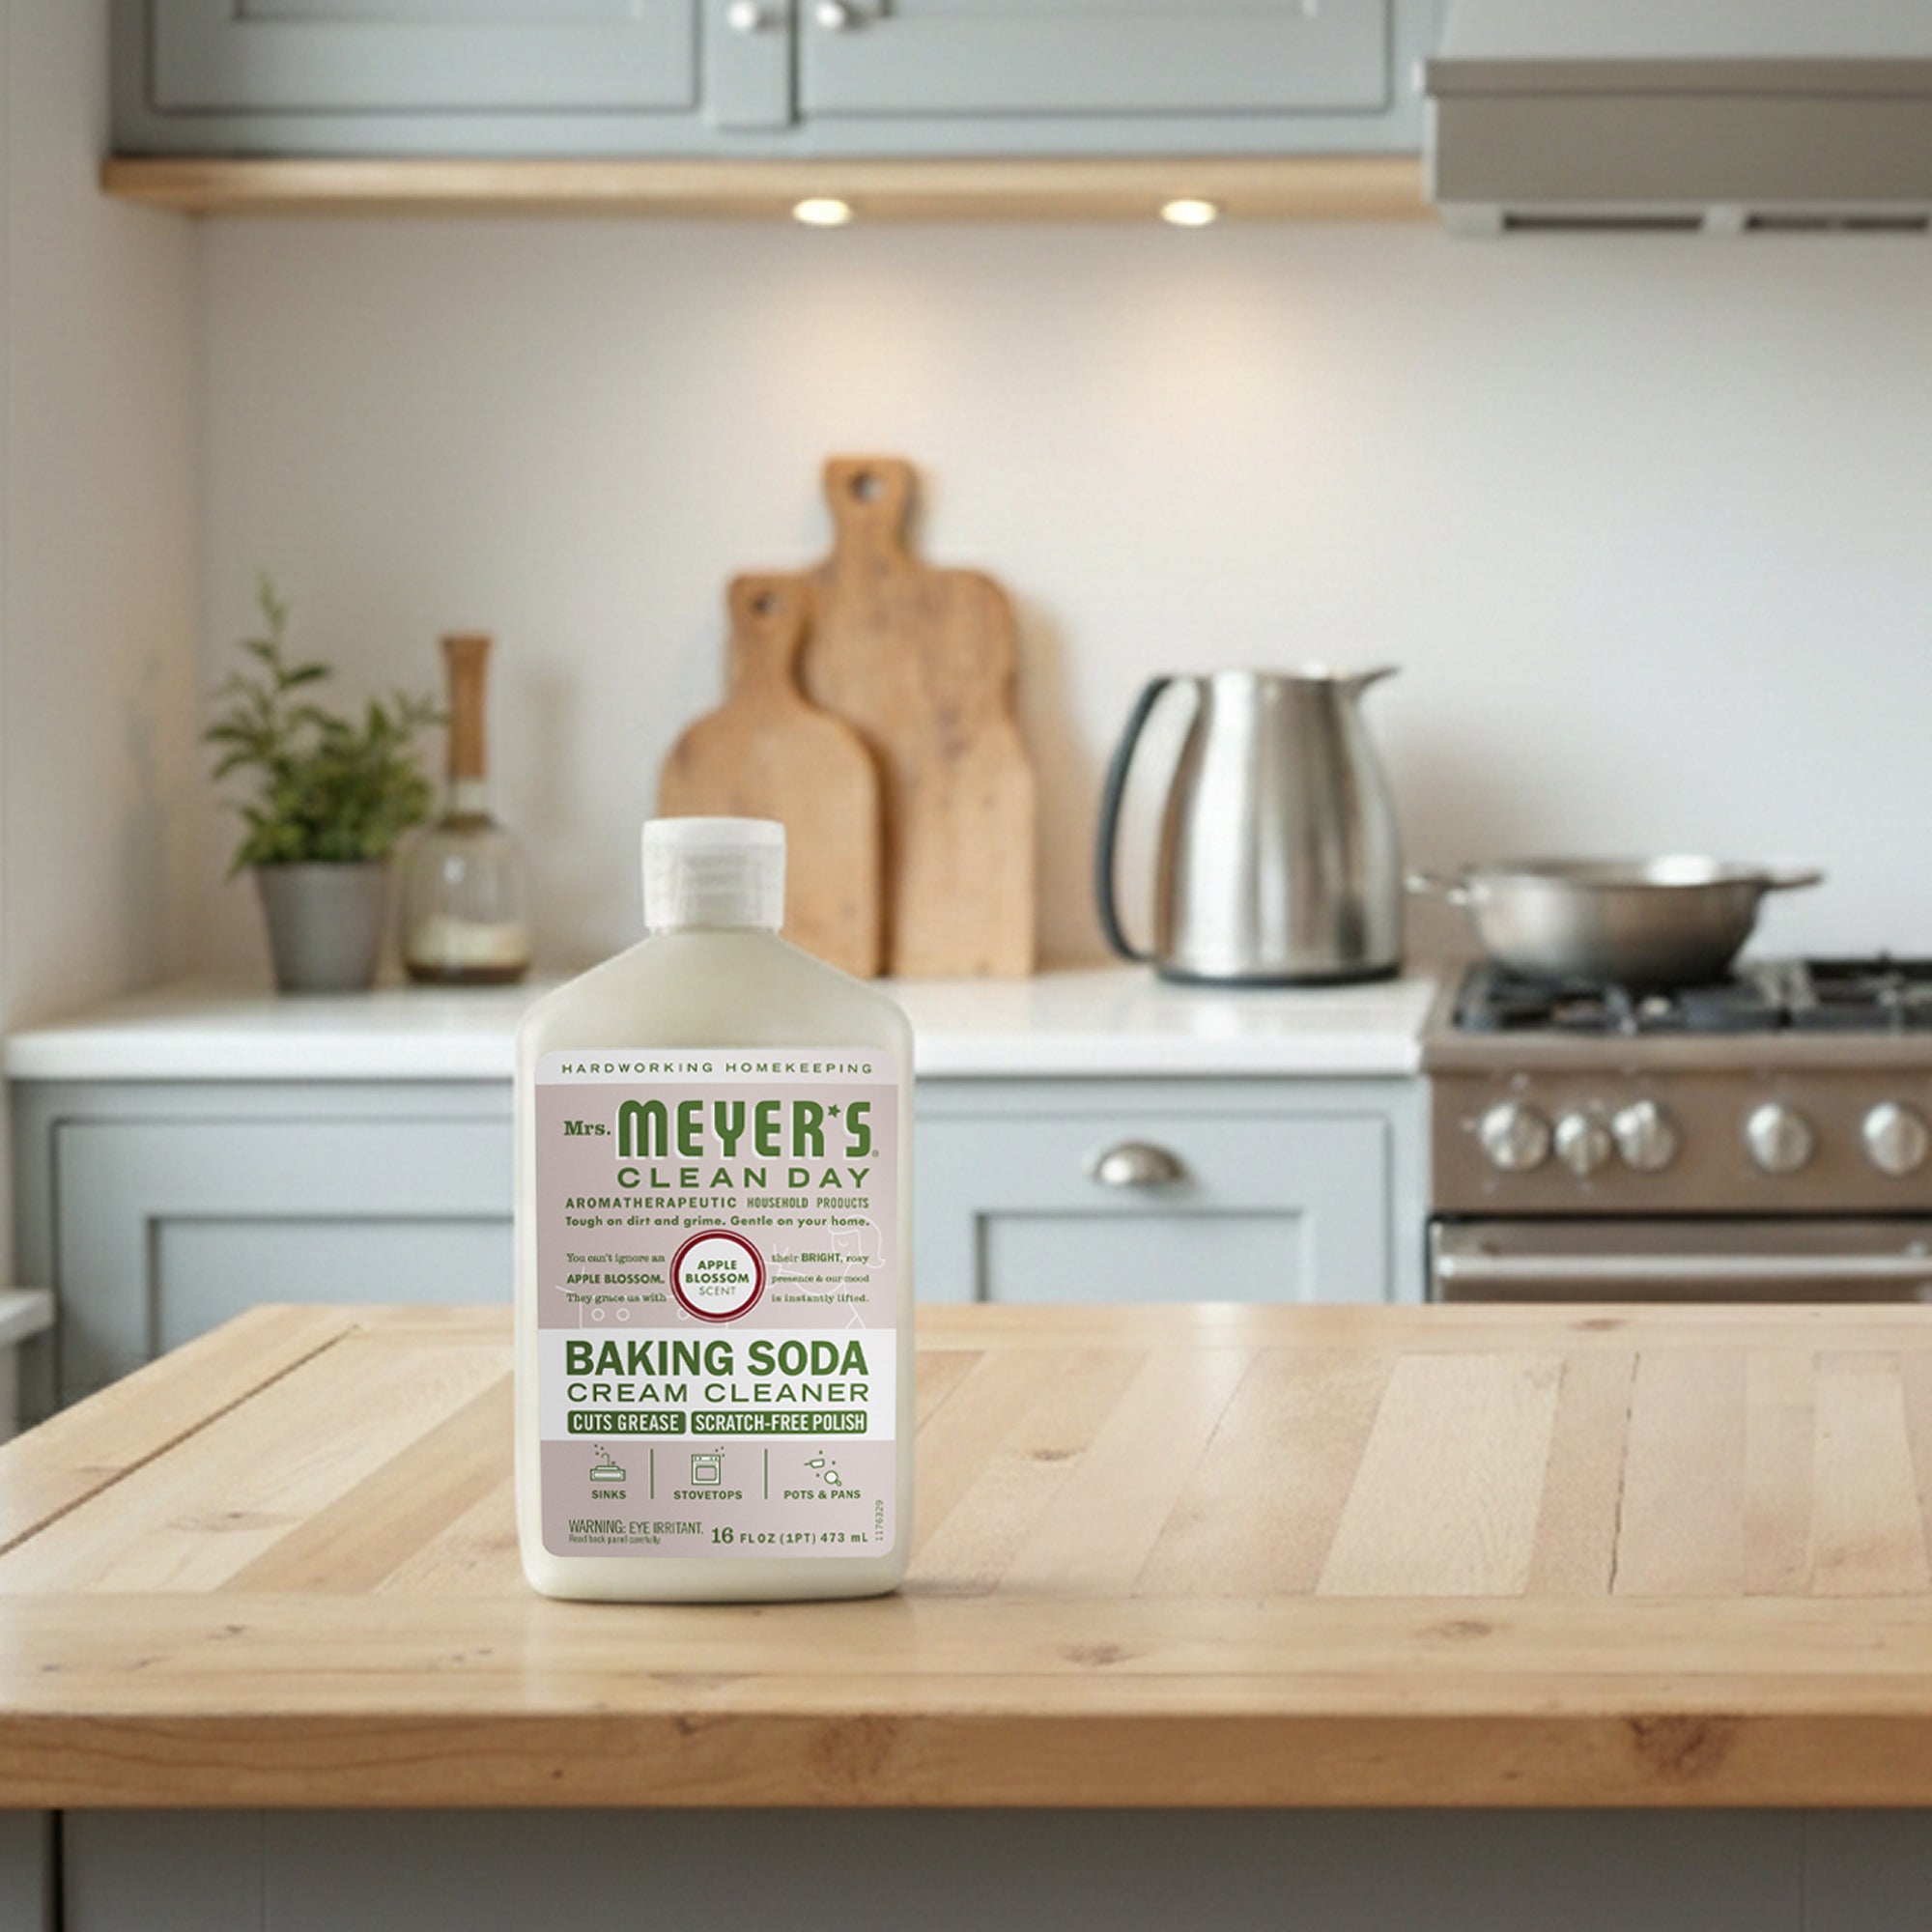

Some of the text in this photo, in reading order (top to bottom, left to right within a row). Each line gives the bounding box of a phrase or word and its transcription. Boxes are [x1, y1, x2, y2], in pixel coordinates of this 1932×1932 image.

[562, 1063, 872, 1074] HARDWORKING HOMEKEEPING
[563, 1121, 611, 1136] Mrs.
[617, 1167, 870, 1188] CLEAN DAY
[565, 1197, 869, 1208] AROMATHERAPEUTIC HOUSEHOLD PRODUCTS
[565, 1215, 870, 1229] Tough on dirt and grime. Gentle on your home.
[566, 1253, 586, 1263] You
[587, 1253, 613, 1263] can't
[615, 1253, 650, 1264] ignore
[772, 1253, 869, 1264] their BRIGHT, rosy
[697, 1261, 738, 1270] APPLE
[566, 1274, 666, 1284] APPLE BLOSSOM.
[685, 1273, 750, 1284] BLOSSOM
[772, 1275, 814, 1285] presence
[844, 1274, 870, 1283] mood
[698, 1287, 737, 1296] SCENT
[566, 1293, 592, 1304] They
[594, 1295, 626, 1304] grace
[641, 1293, 667, 1302] with
[772, 1293, 869, 1304] is instantly lifted.
[566, 1340, 869, 1377] BAKING SODA
[567, 1382, 869, 1403] CREAM CLEANER
[573, 1413, 679, 1432] CUTS GREASE
[695, 1413, 865, 1432] SCRATCH-FREE POLISH
[591, 1490, 627, 1499] SINKS
[673, 1490, 743, 1500] STOVETOPS
[783, 1490, 861, 1499] POTS & PANS
[568, 1519, 704, 1535] WARNING: EYE IRRITANT.
[568, 1534, 587, 1544] Read
[608, 1535, 628, 1545] panel
[711, 1526, 734, 1544] 16
[780, 1532, 816, 1545] (1PT)
[820, 1532, 845, 1543] 473
[850, 1532, 868, 1543] mL
